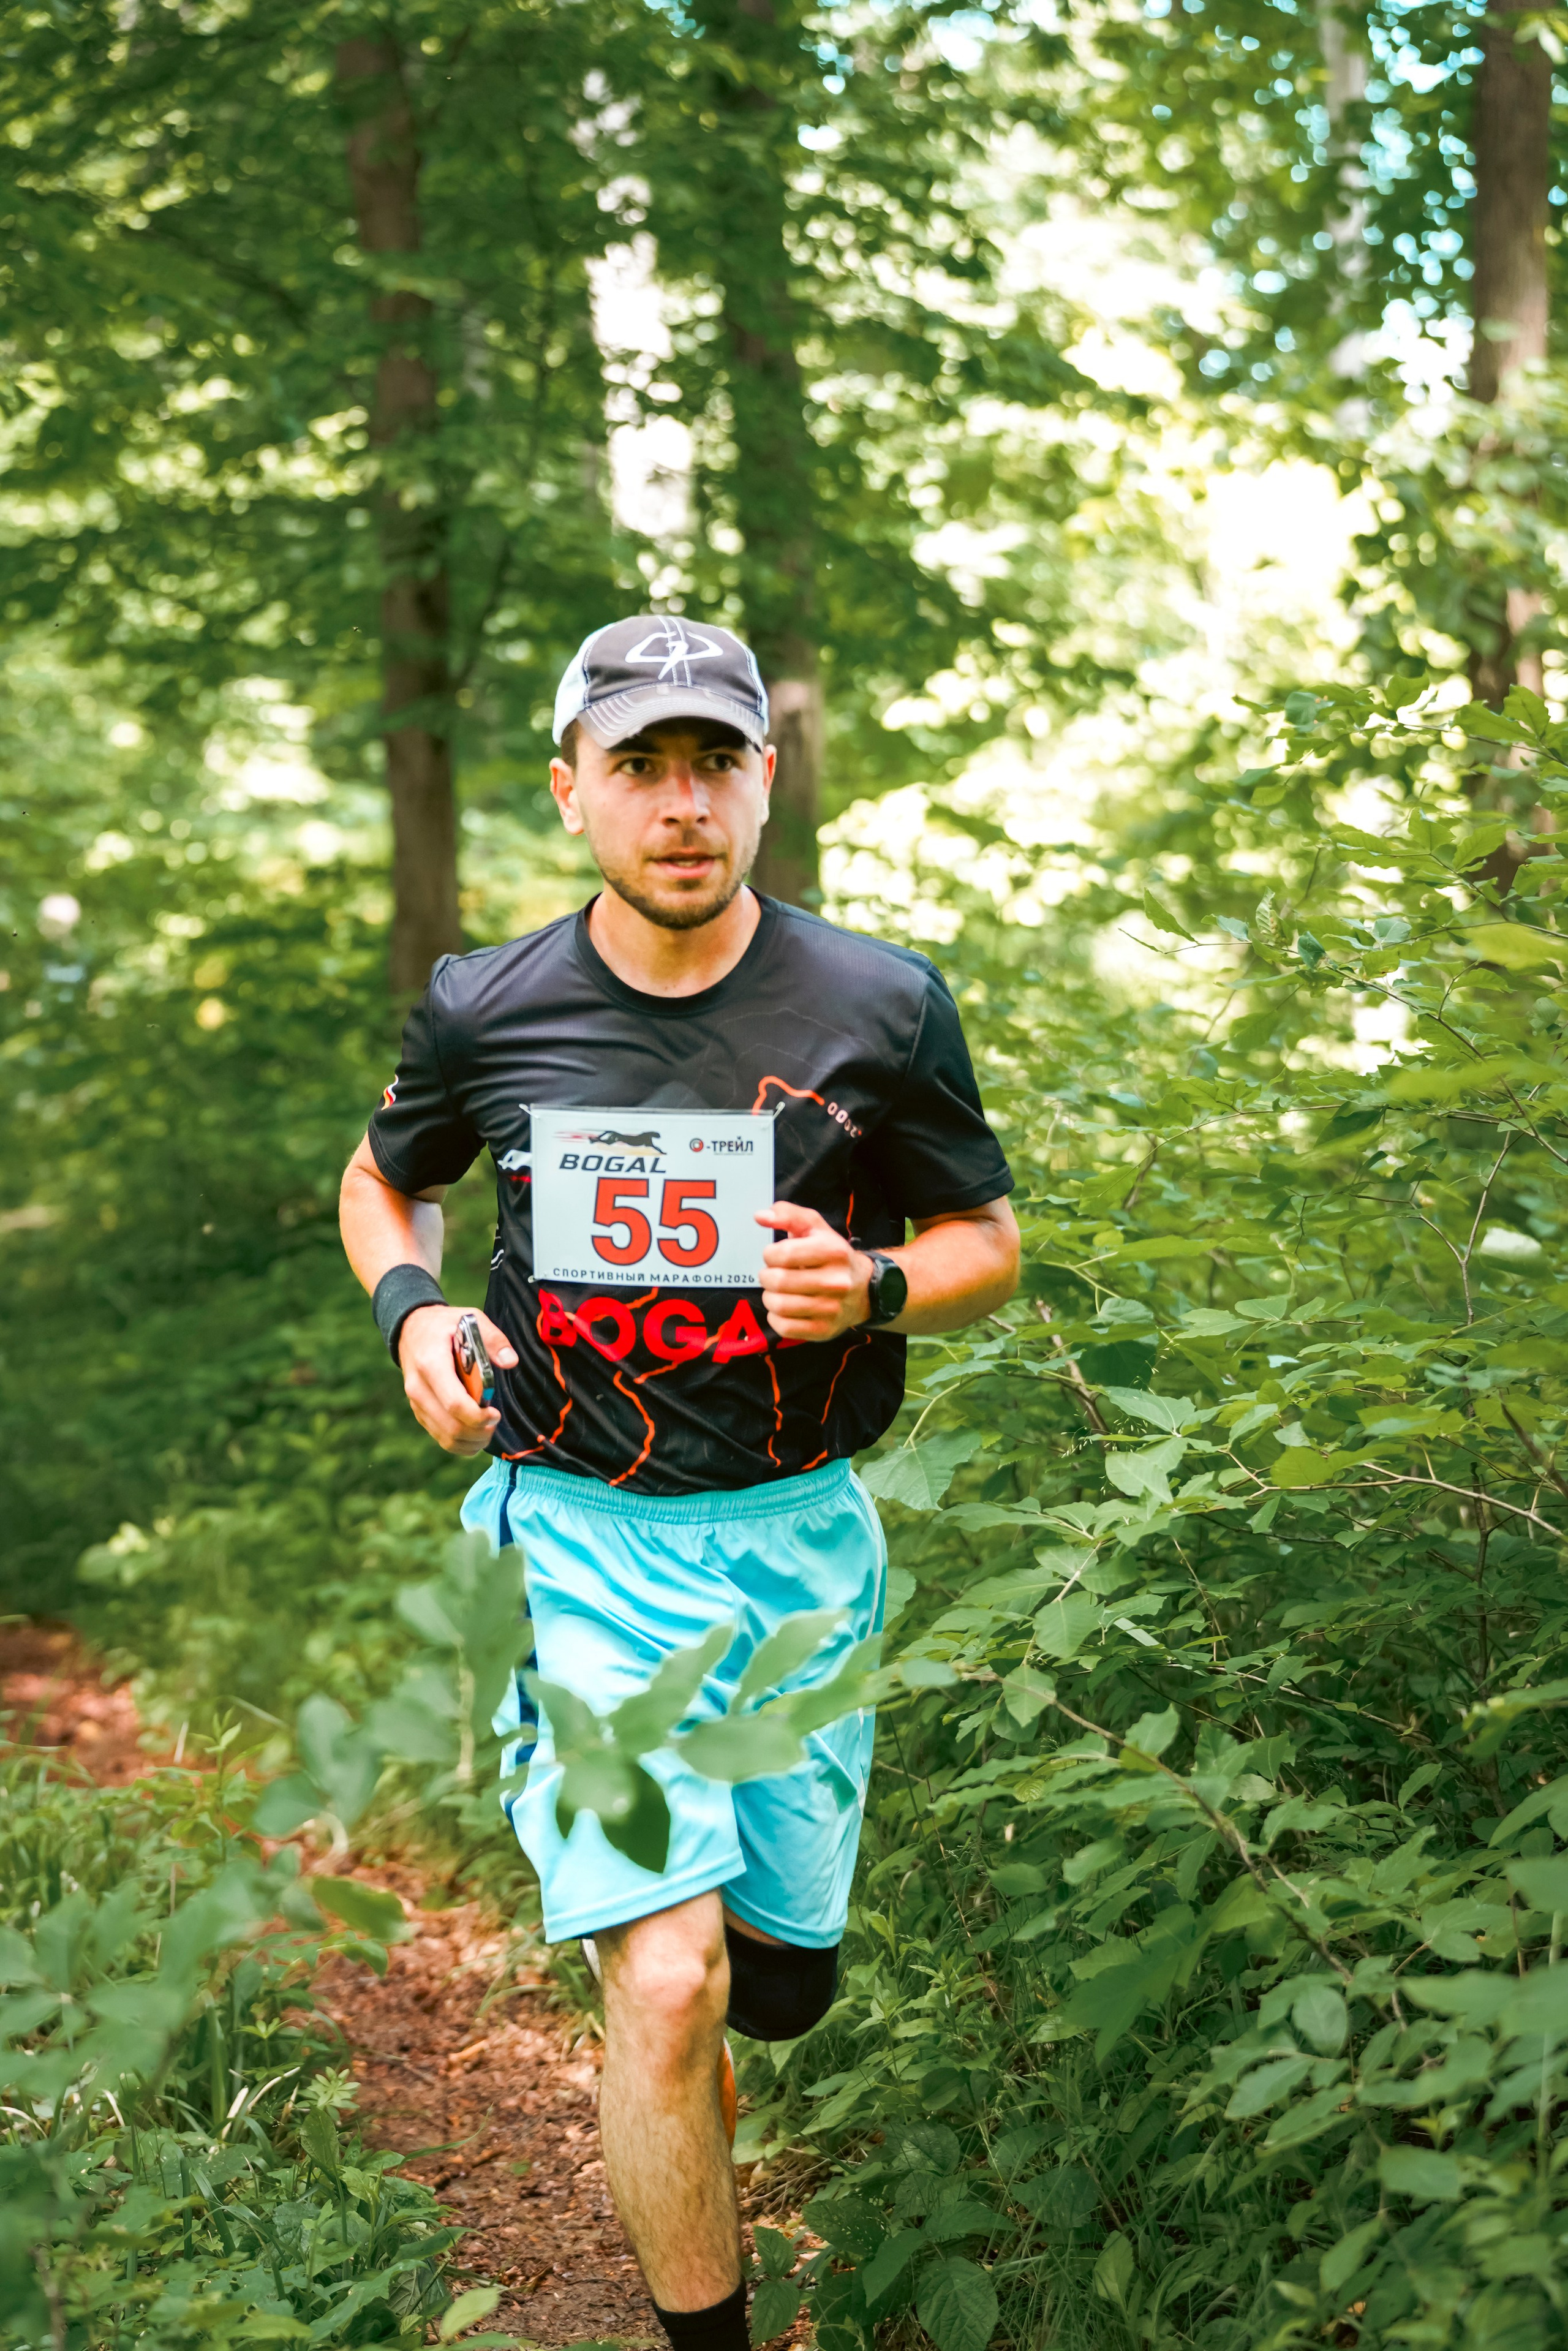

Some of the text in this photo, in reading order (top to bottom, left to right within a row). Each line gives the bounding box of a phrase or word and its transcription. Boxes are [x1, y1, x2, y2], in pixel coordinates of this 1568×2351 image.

[559, 1154, 666, 1173] BOGAL
[591, 1177, 719, 1268] 55
[553, 1267, 755, 1283] СПОРТИВНЫЙ МАРАФОН 2026
[538, 1288, 807, 1364] BOGA
